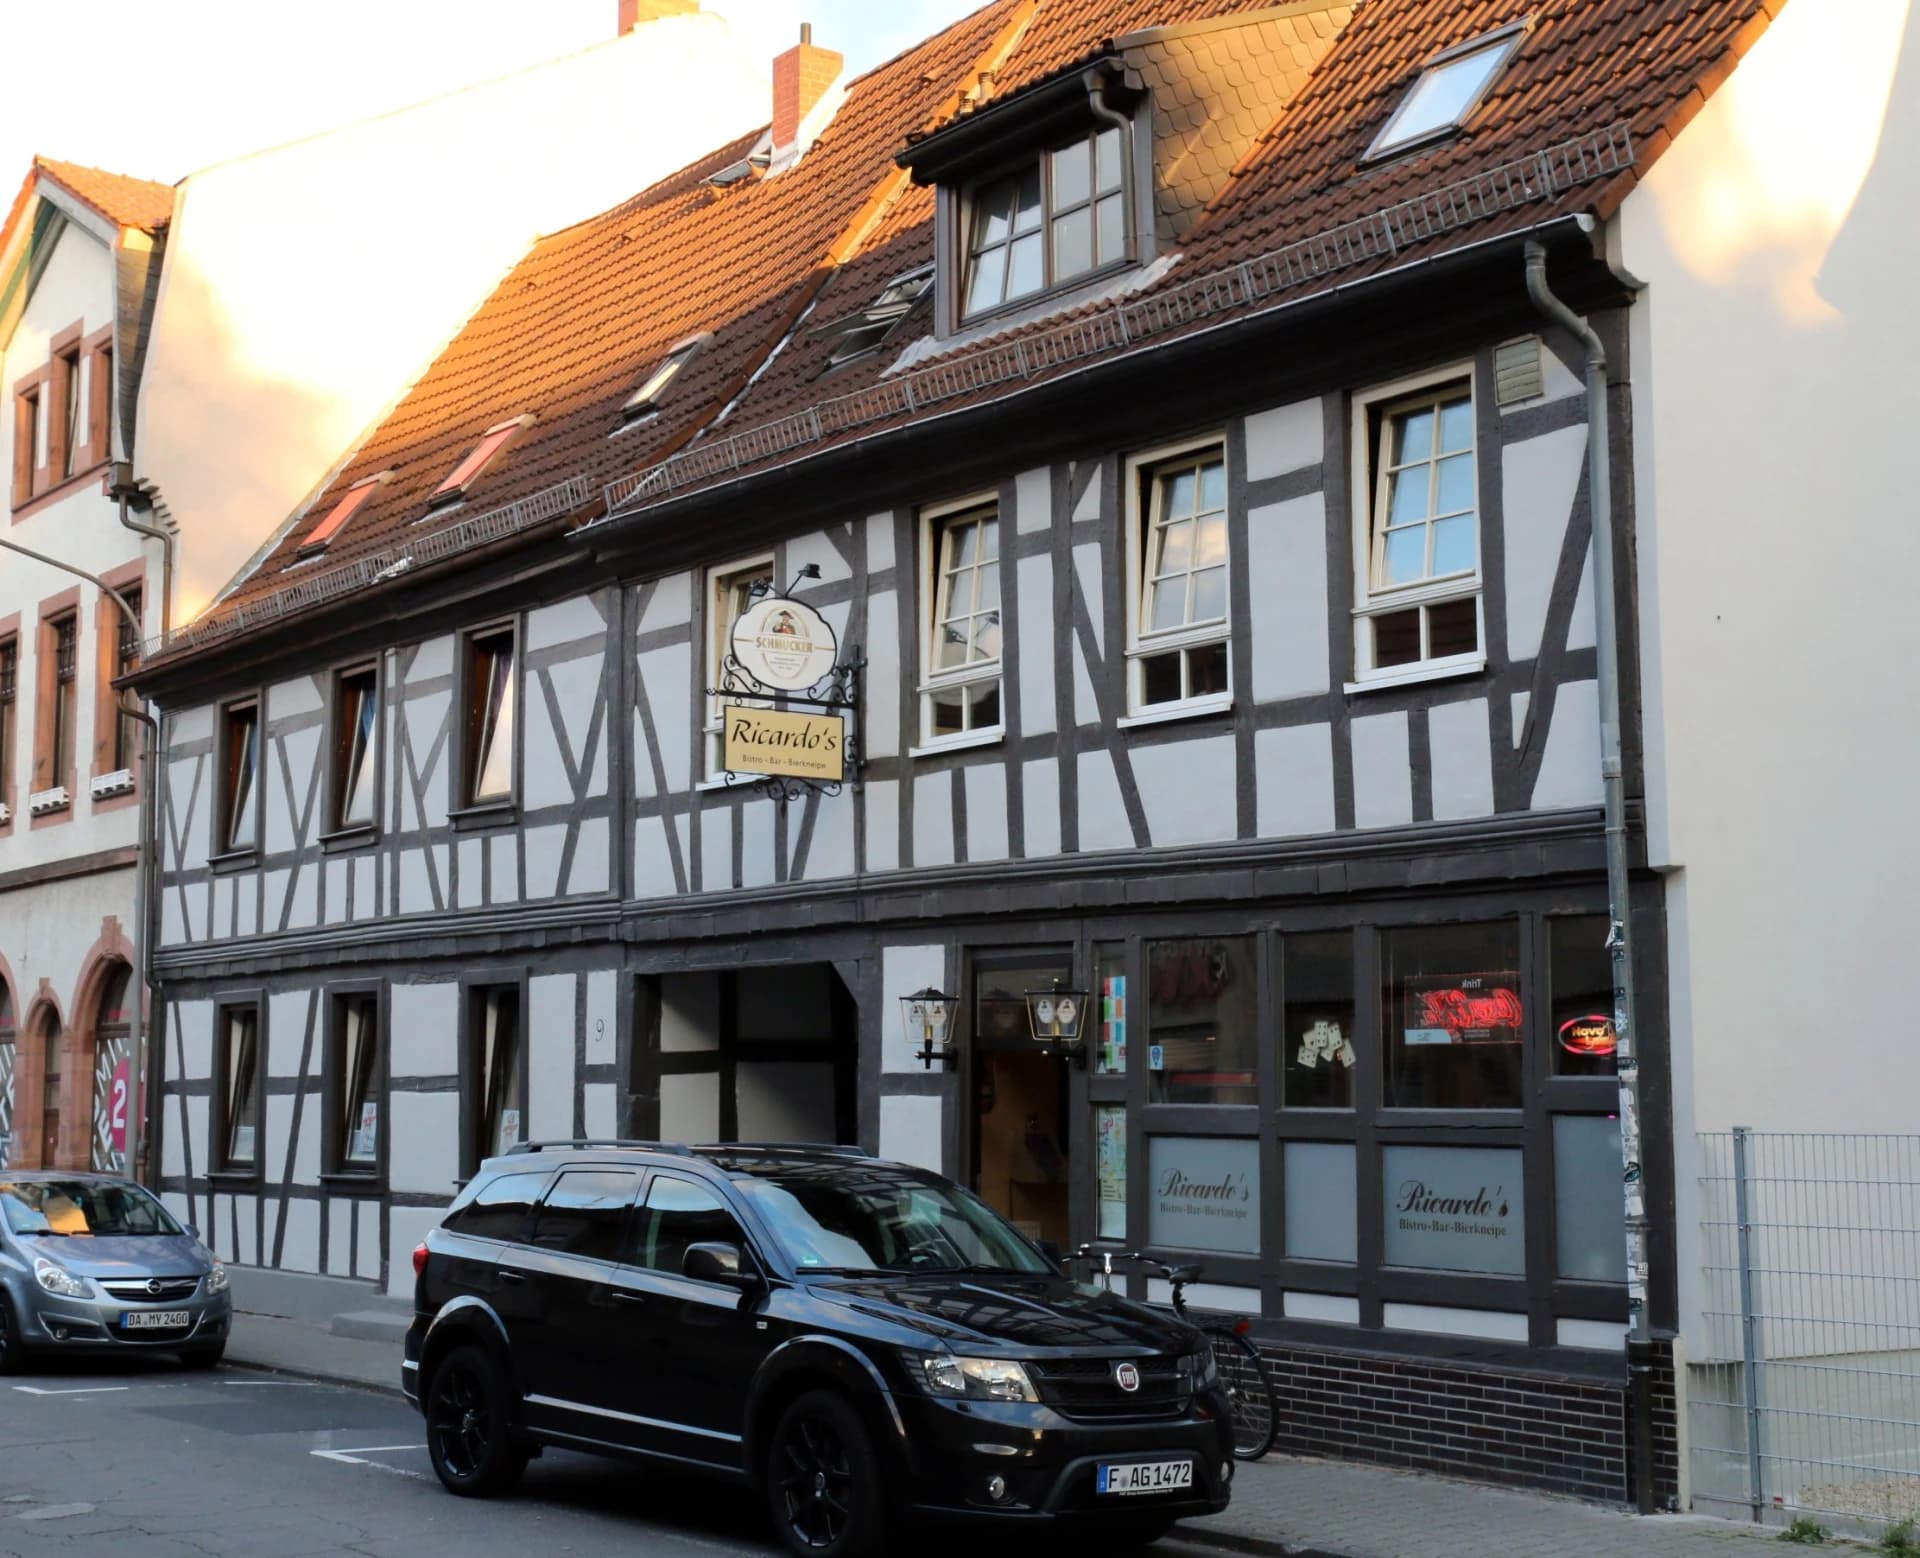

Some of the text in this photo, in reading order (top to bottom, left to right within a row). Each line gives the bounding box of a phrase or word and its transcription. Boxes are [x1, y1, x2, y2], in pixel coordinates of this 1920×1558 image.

[756, 636, 813, 653] SCHMUCKER
[732, 719, 837, 751] Ricardo's
[742, 754, 763, 764] Bistro
[770, 756, 782, 765] Bar
[113, 1079, 126, 1128] 2
[1158, 1168, 1249, 1201] Ricardo's
[1396, 1179, 1508, 1217] Ricardo's
[1109, 1463, 1190, 1489] F AG 1472
